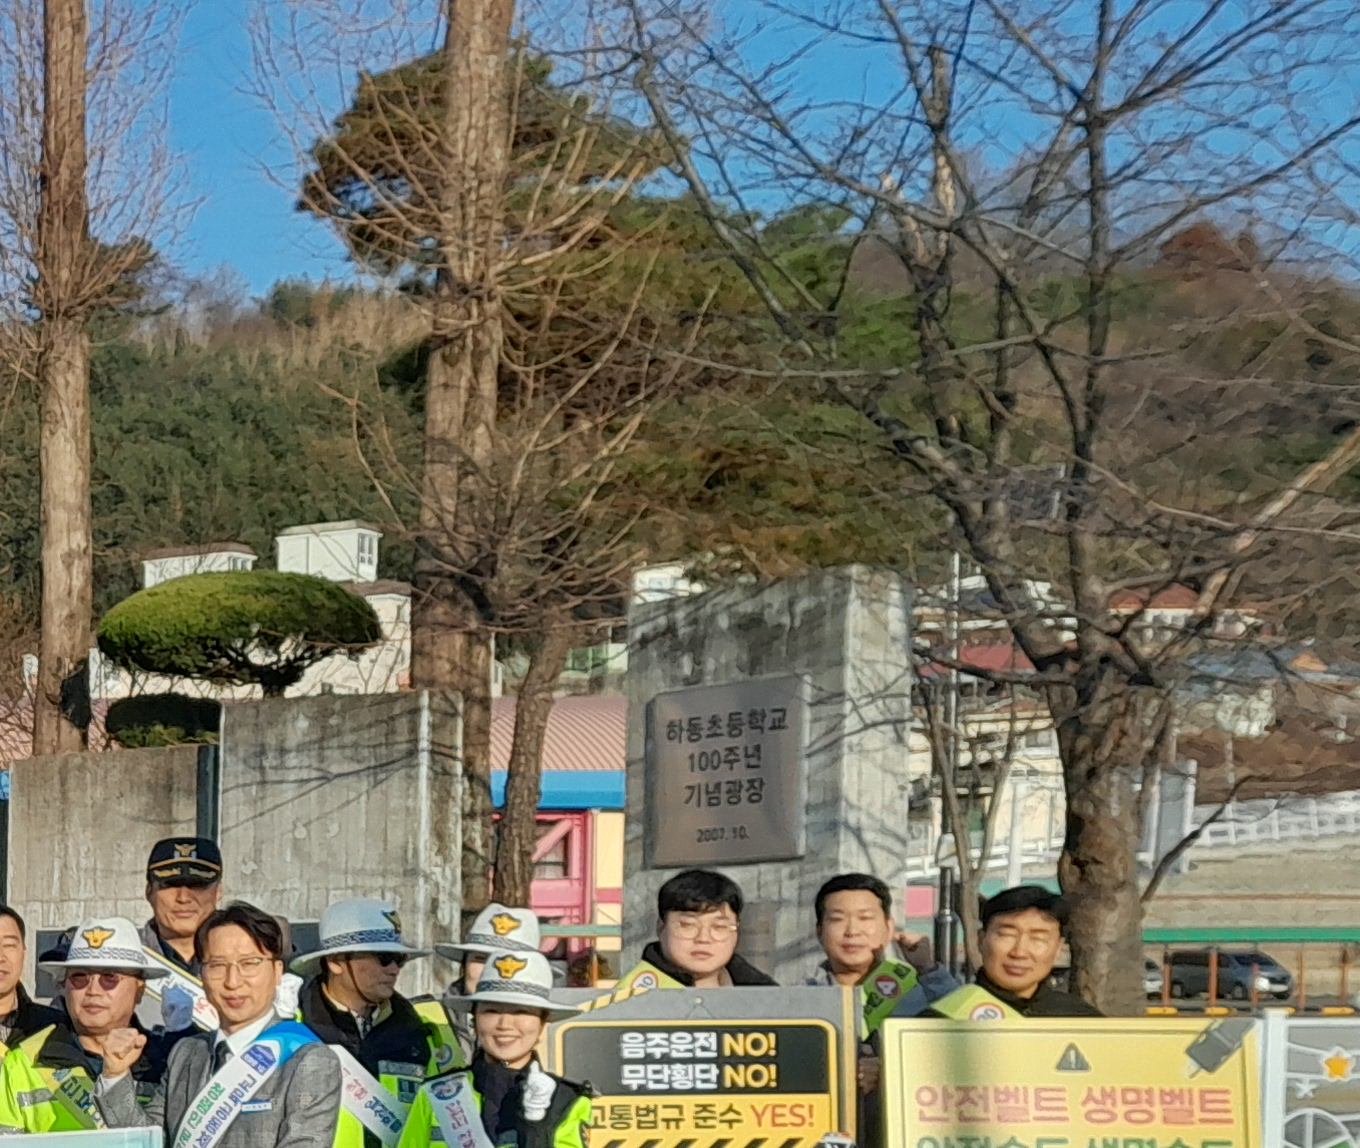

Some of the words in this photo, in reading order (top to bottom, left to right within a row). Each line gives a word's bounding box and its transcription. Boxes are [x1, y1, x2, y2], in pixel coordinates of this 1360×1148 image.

[667, 708, 788, 744] 하동초등학교
[688, 744, 761, 773] 100주년
[684, 777, 766, 808] 기념광장
[620, 1031, 719, 1059] 음주운전
[722, 1032, 777, 1057] NO!
[620, 1063, 719, 1090] 무단횡단
[723, 1063, 777, 1088] NO!
[590, 1104, 685, 1131] 교통법규
[693, 1104, 744, 1130] 준수
[750, 1104, 815, 1128] YES!
[915, 1084, 1069, 1125] 안전벨트
[1081, 1085, 1235, 1126] 생명벨트
